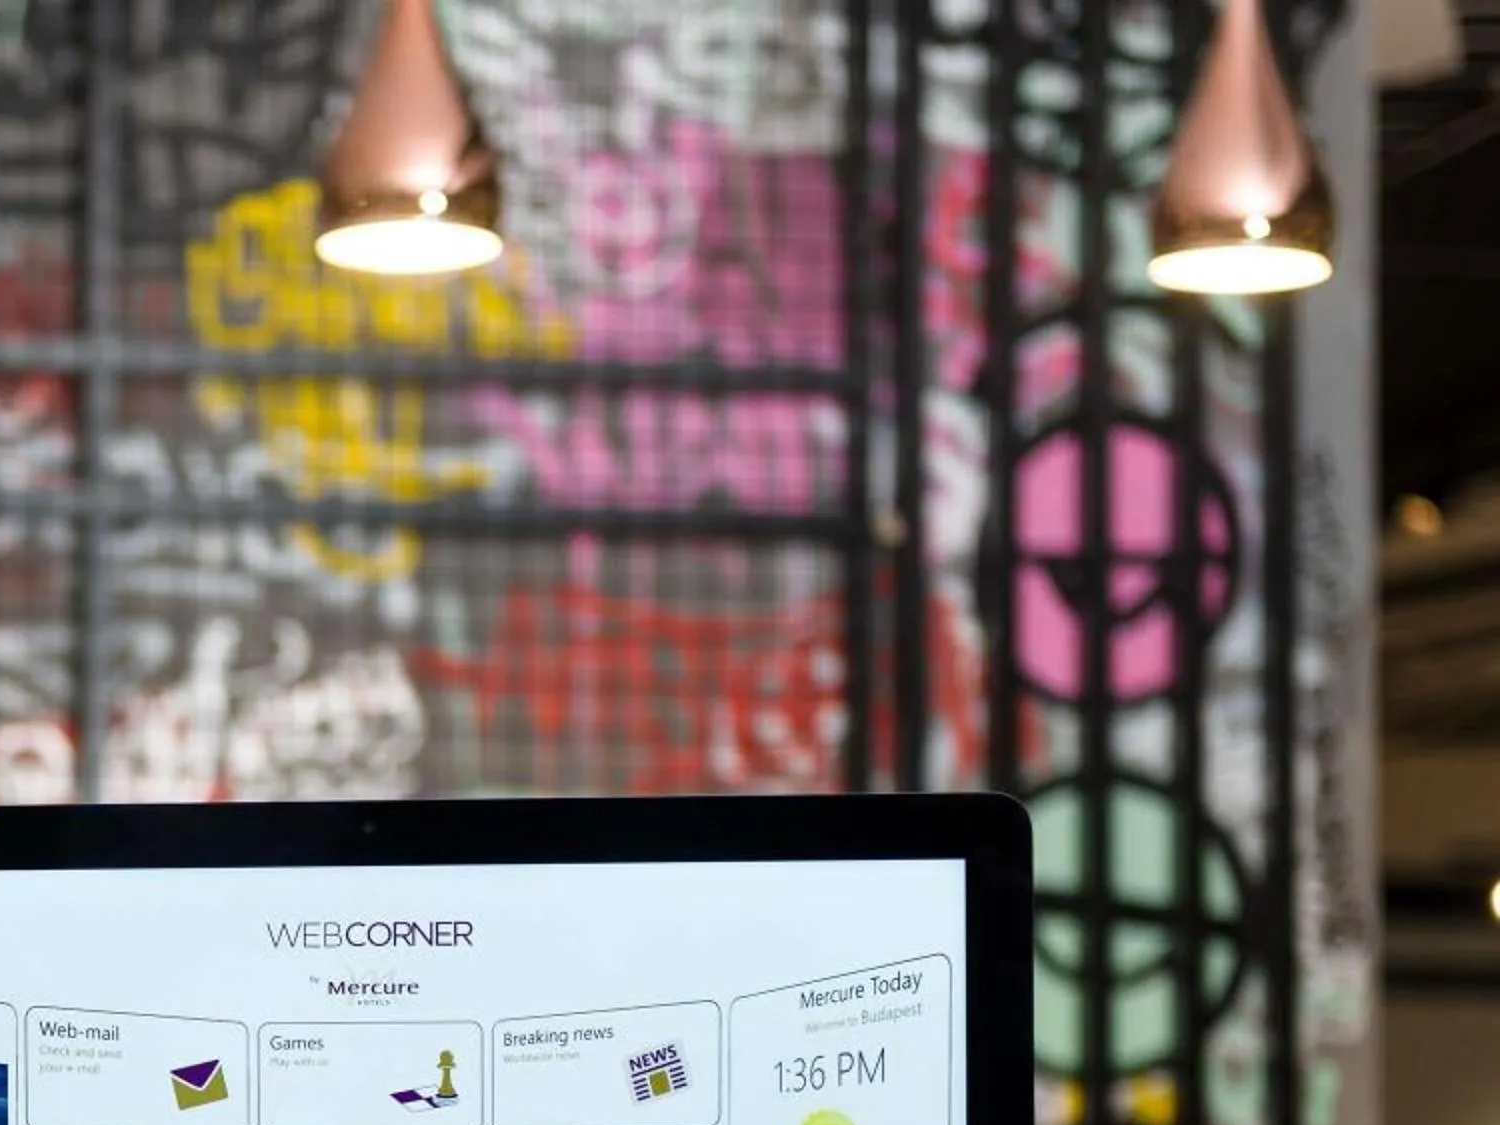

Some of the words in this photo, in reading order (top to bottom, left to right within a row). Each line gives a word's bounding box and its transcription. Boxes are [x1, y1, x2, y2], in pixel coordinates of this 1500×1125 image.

[327, 980, 420, 995] Mercure
[800, 987, 865, 1009] Mercure
[870, 971, 923, 994] Today
[861, 1002, 921, 1025] Budapest
[39, 1020, 119, 1041] Web-mail
[503, 1029, 569, 1047] Breaking
[573, 1026, 614, 1041] news
[269, 1035, 325, 1051] Games
[629, 1044, 678, 1072] NEWS
[774, 1055, 826, 1093] 1:36
[837, 1048, 886, 1086] PM
